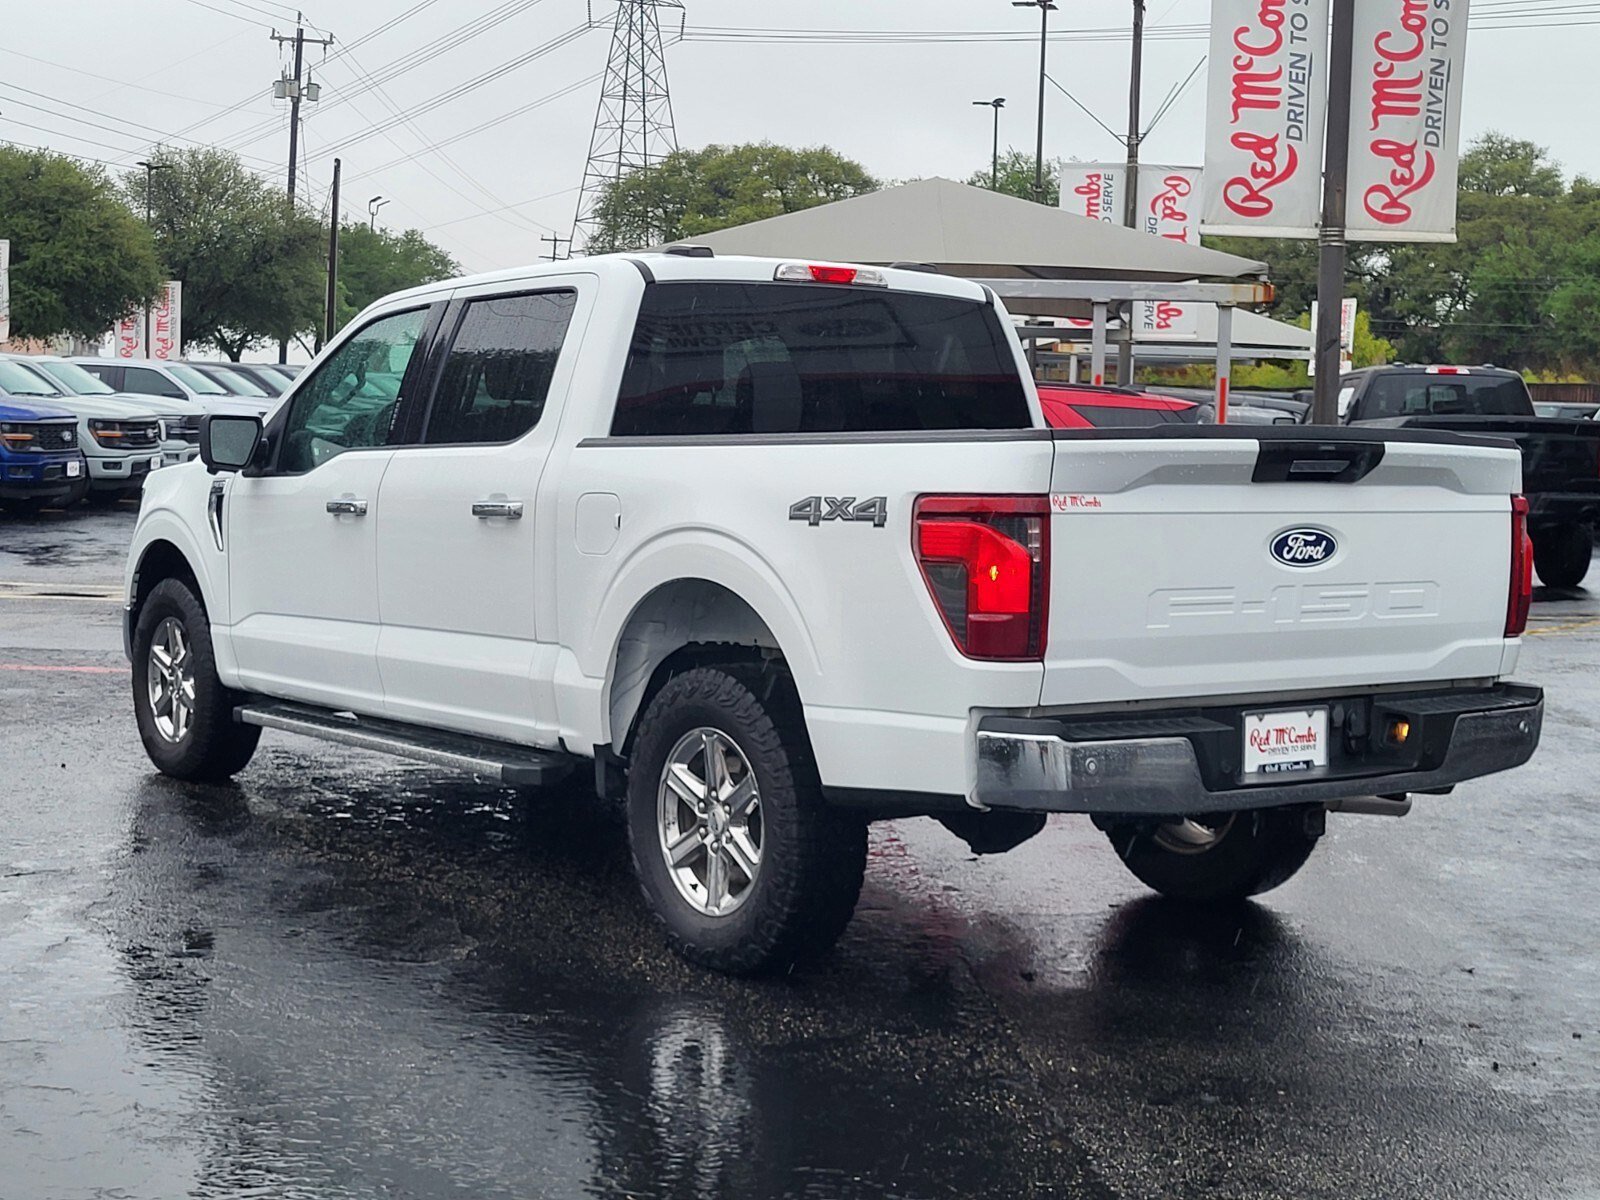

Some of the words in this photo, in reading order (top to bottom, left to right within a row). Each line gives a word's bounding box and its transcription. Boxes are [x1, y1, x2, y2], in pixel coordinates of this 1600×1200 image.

[1290, 12, 1308, 45] TO
[1431, 17, 1449, 50] TO
[1286, 52, 1307, 142] DRIVEN
[1424, 58, 1446, 148] DRIVEN
[1223, 132, 1298, 218] Red
[1363, 139, 1435, 225] Red
[1102, 173, 1114, 213] SERVE
[1150, 175, 1192, 222] Red
[120, 335, 139, 359] Red
[155, 336, 174, 360] Red
[1052, 494, 1067, 511] Red
[1282, 533, 1328, 560] Ford
[1146, 579, 1441, 630] F-150
[1250, 728, 1271, 753] Red
[1272, 726, 1317, 745] McCombs
[1268, 746, 1290, 756] DRIVEN
[1290, 745, 1299, 753] TO
[1299, 743, 1317, 752] SERVE
